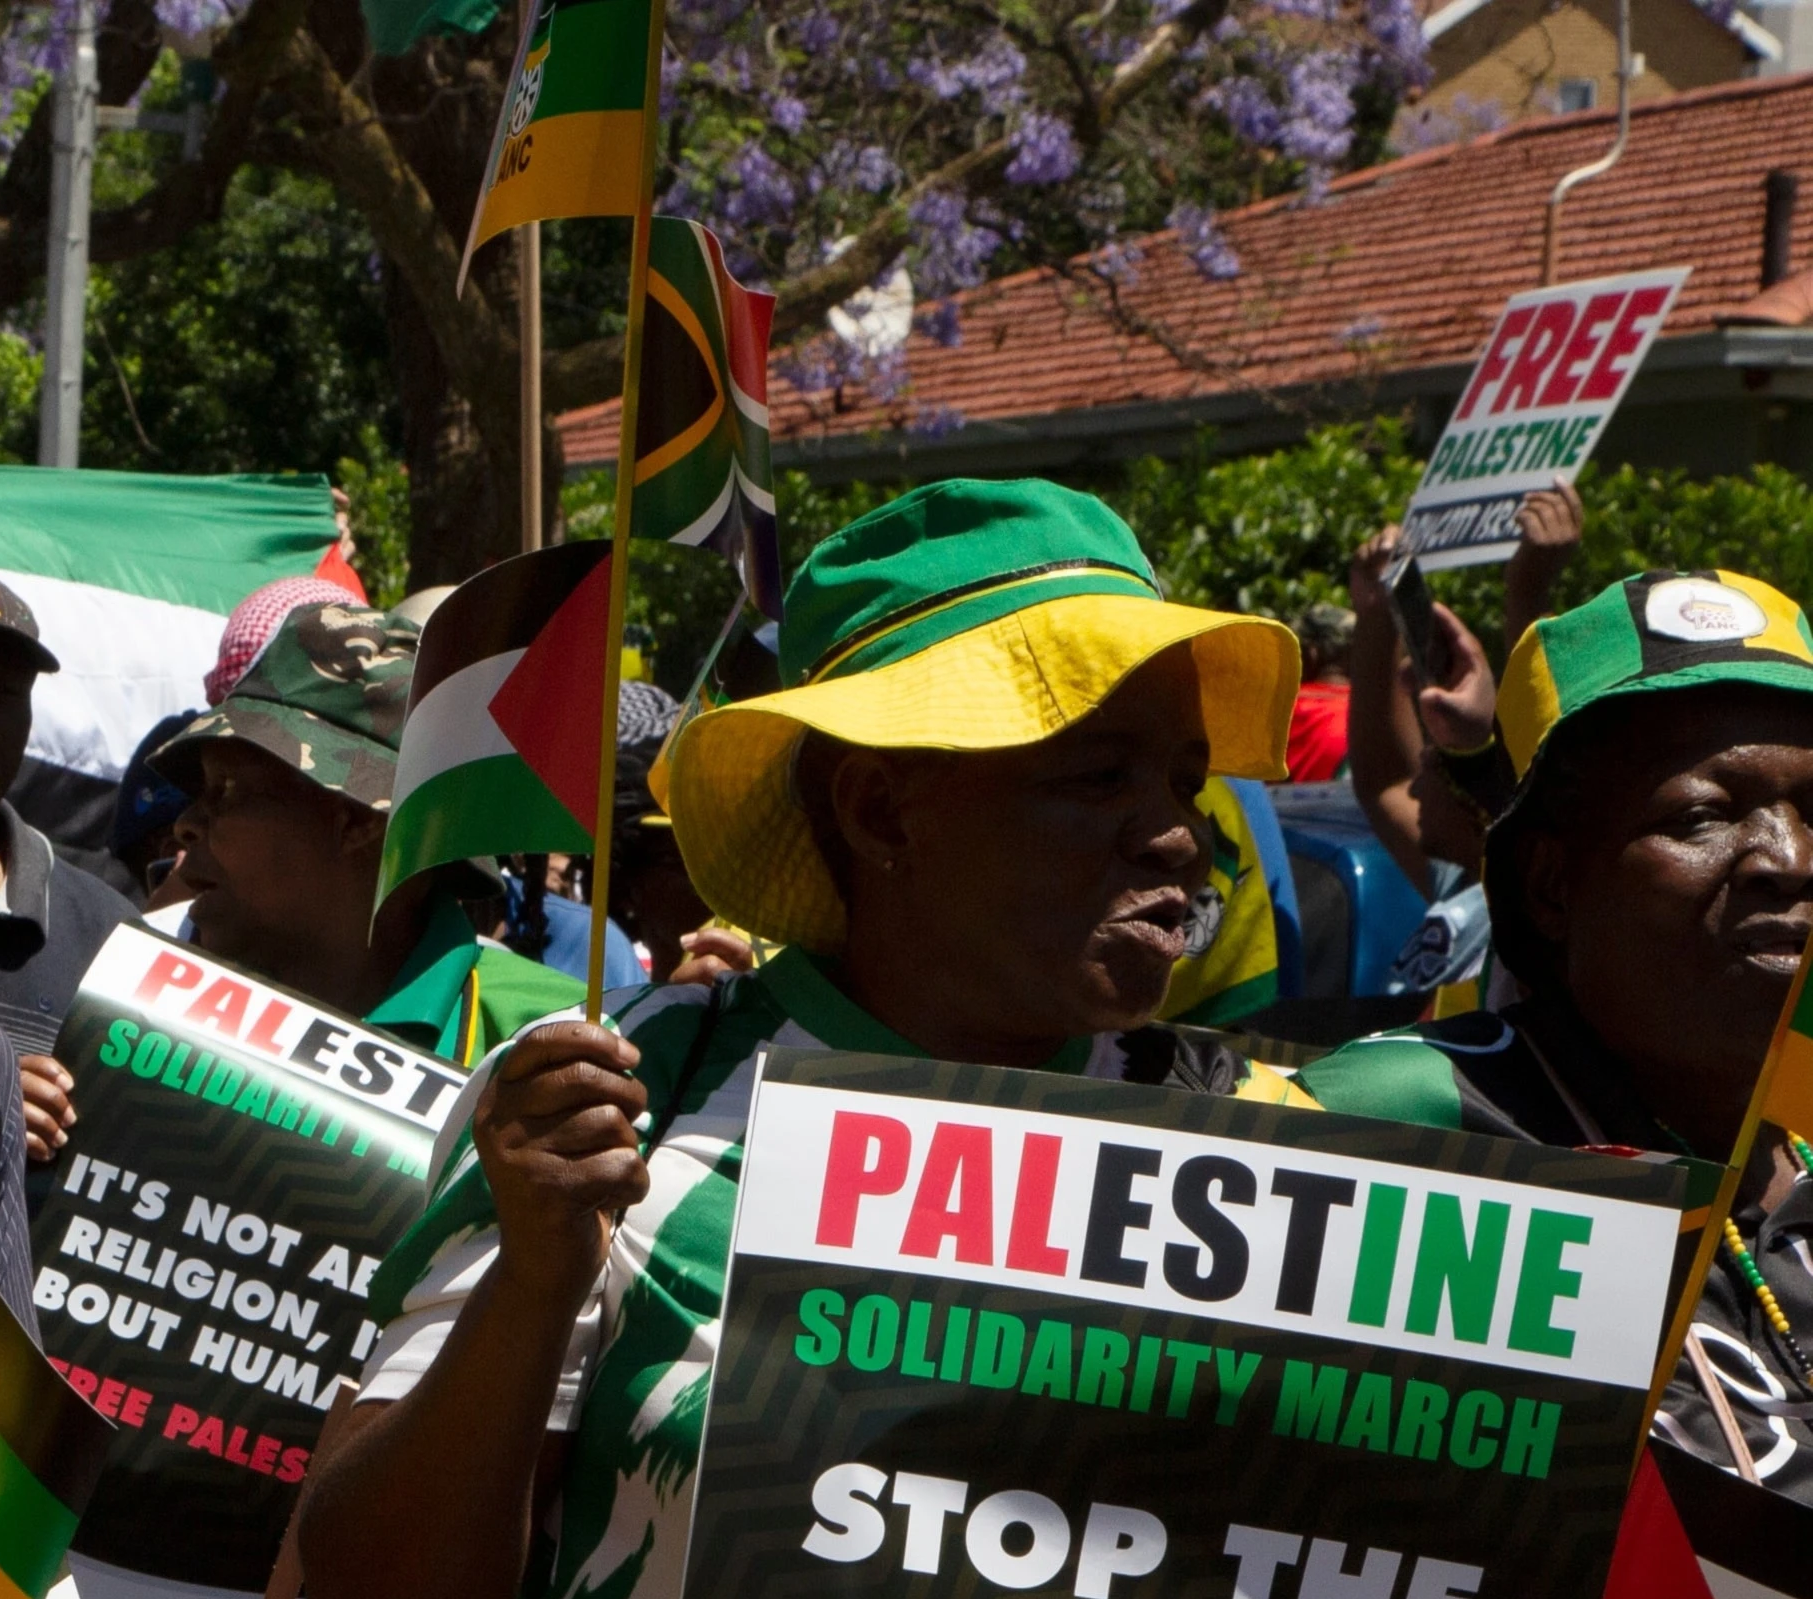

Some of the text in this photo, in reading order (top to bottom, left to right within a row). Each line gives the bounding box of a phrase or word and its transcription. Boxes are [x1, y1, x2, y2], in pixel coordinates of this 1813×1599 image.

[1456, 286, 1673, 422] FREE
[1424, 415, 1603, 488] PALESTINE
[99, 1018, 375, 1158] SOLIDARITY
[132, 950, 467, 1118] PALEST
[64, 1153, 302, 1268] IT'S NOT
[815, 1109, 1593, 1360] PALESTINE
[31, 1266, 181, 1350] BOUT
[60, 1215, 331, 1352] RELIGION,
[162, 1403, 312, 1483] PALES
[793, 1288, 1563, 1480] SOLIDARITY MARCH
